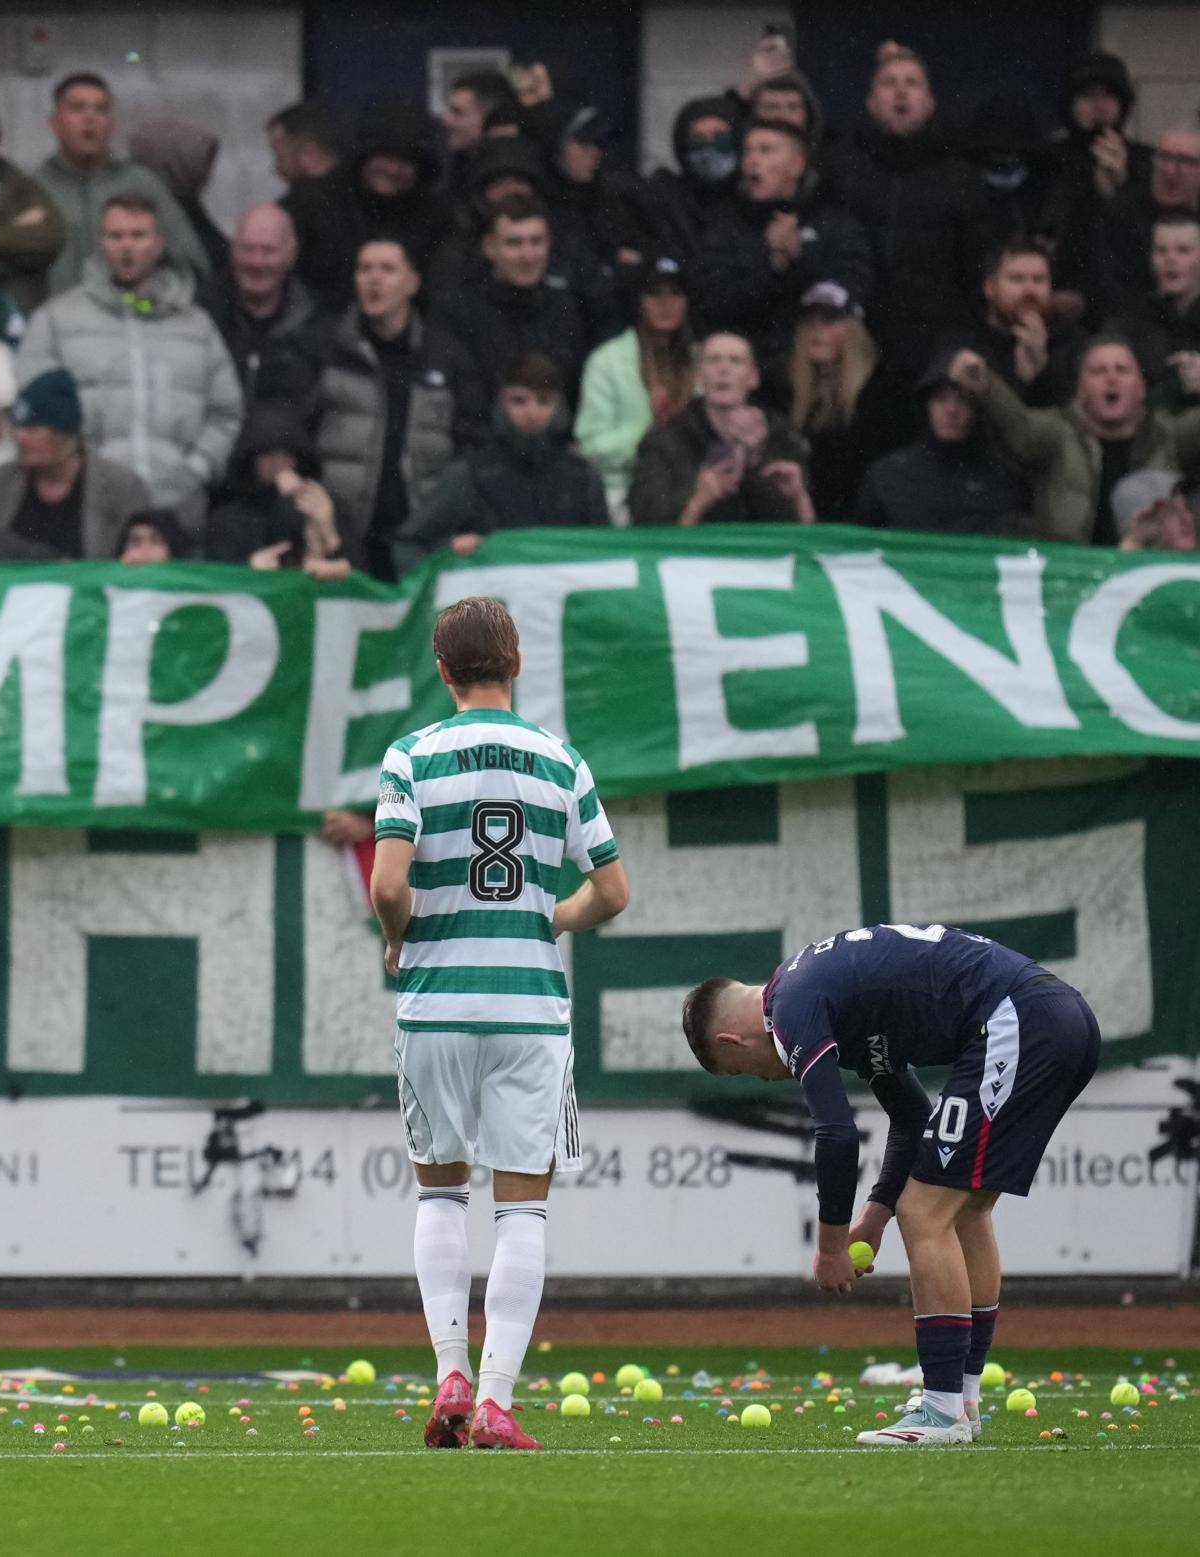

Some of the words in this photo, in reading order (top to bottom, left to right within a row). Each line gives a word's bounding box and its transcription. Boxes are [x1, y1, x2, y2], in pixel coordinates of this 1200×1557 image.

[456, 746, 535, 775] NYGREN
[468, 799, 526, 904] 8
[646, 1146, 733, 1188] 828
